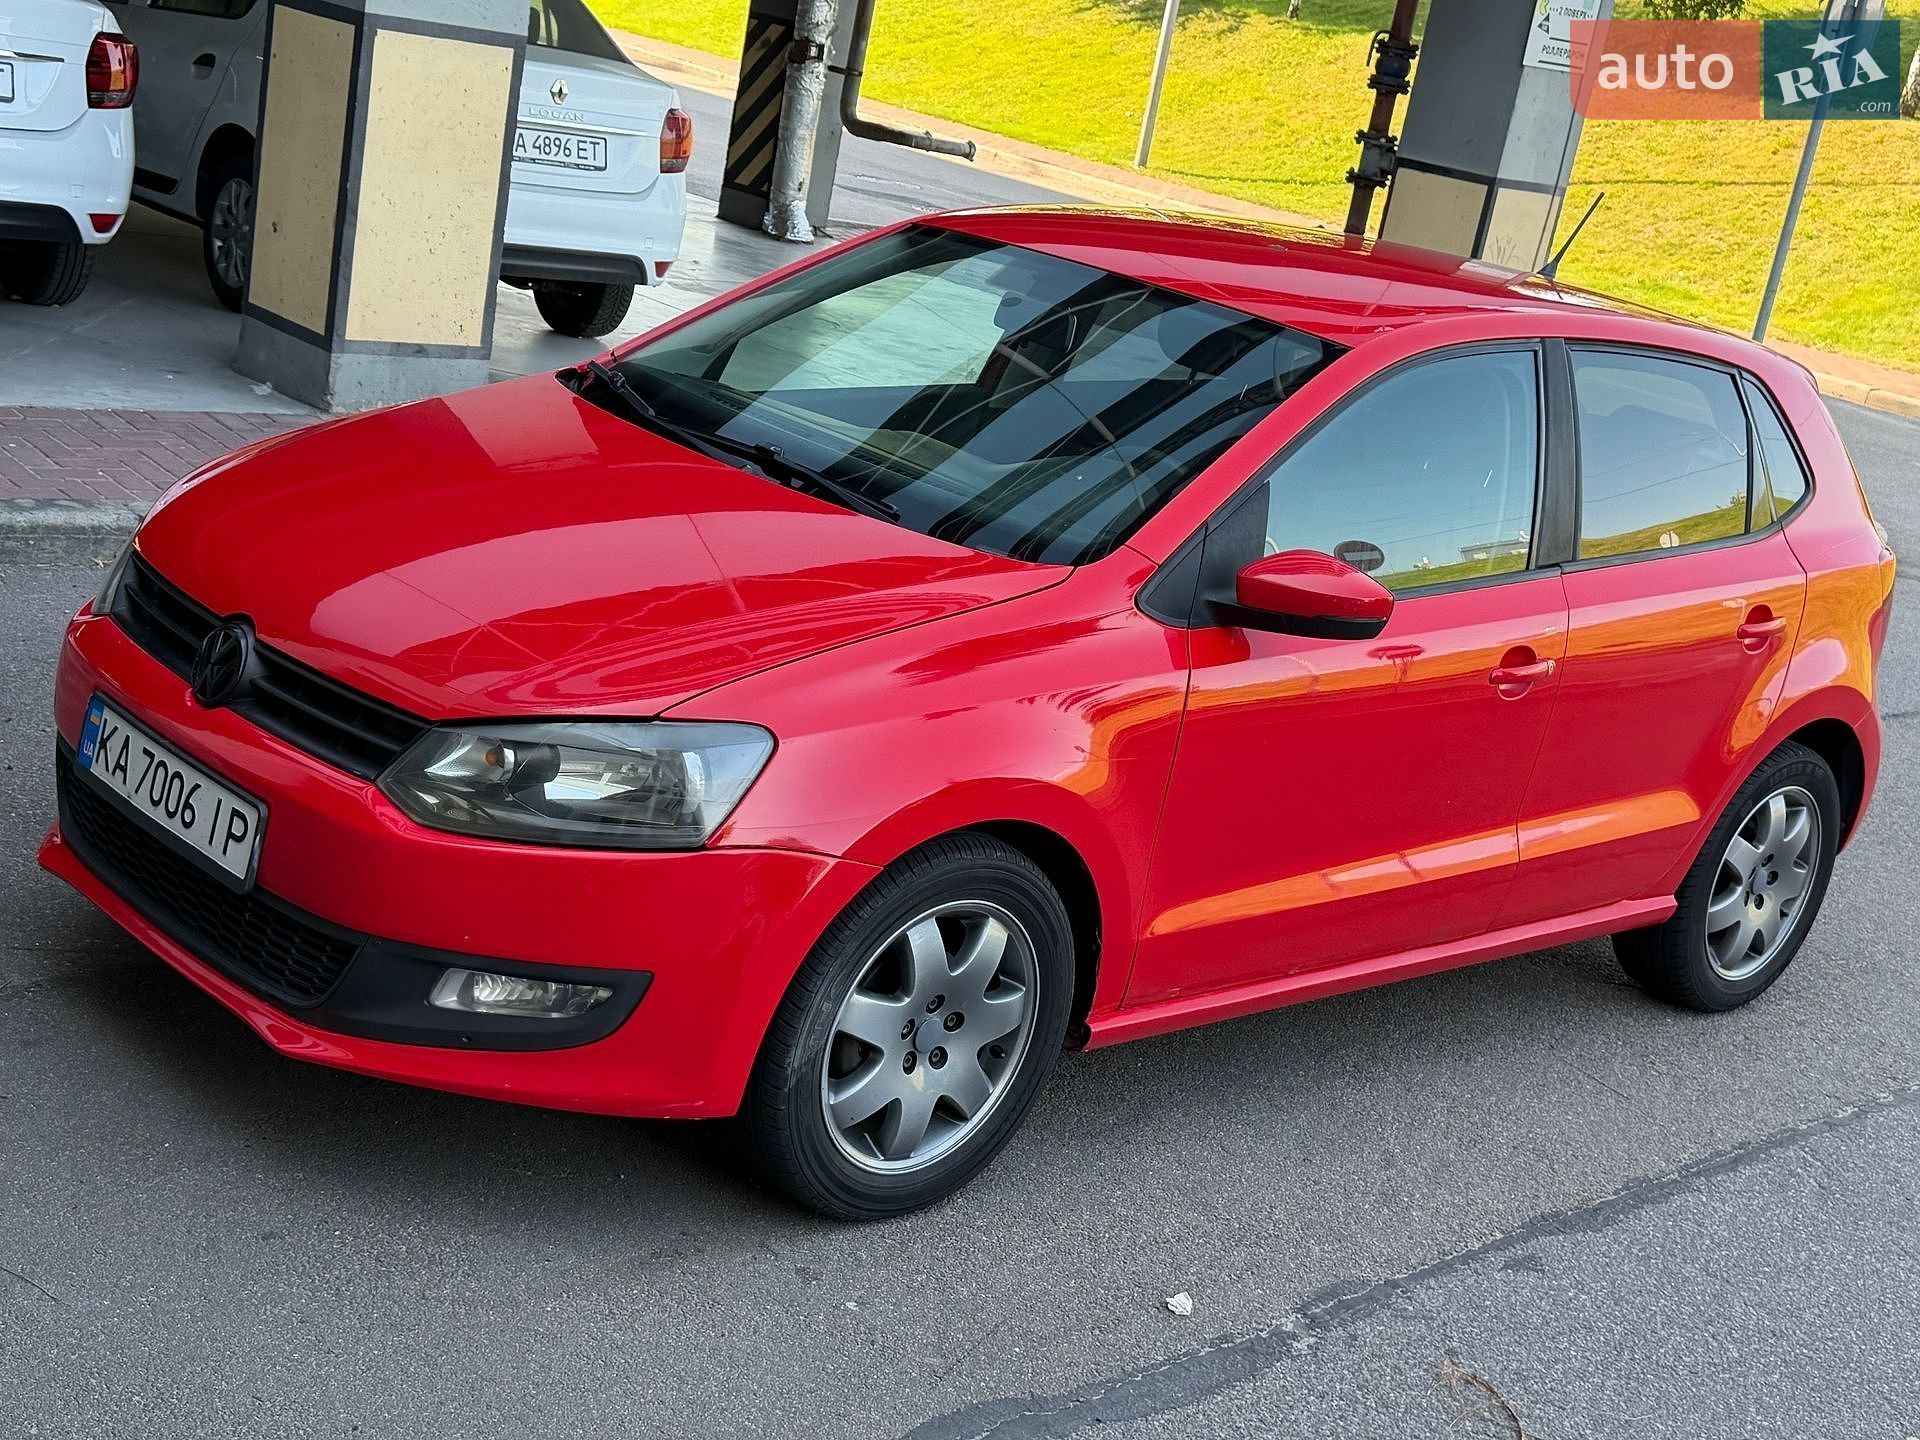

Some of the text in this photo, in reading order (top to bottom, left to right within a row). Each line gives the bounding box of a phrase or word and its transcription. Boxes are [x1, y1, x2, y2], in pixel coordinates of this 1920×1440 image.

[528, 107, 585, 123] LOGAN
[532, 134, 572, 158] 4896
[577, 139, 601, 161] ET
[83, 739, 94, 758] UA
[95, 718, 249, 856] KA 7006 IP
